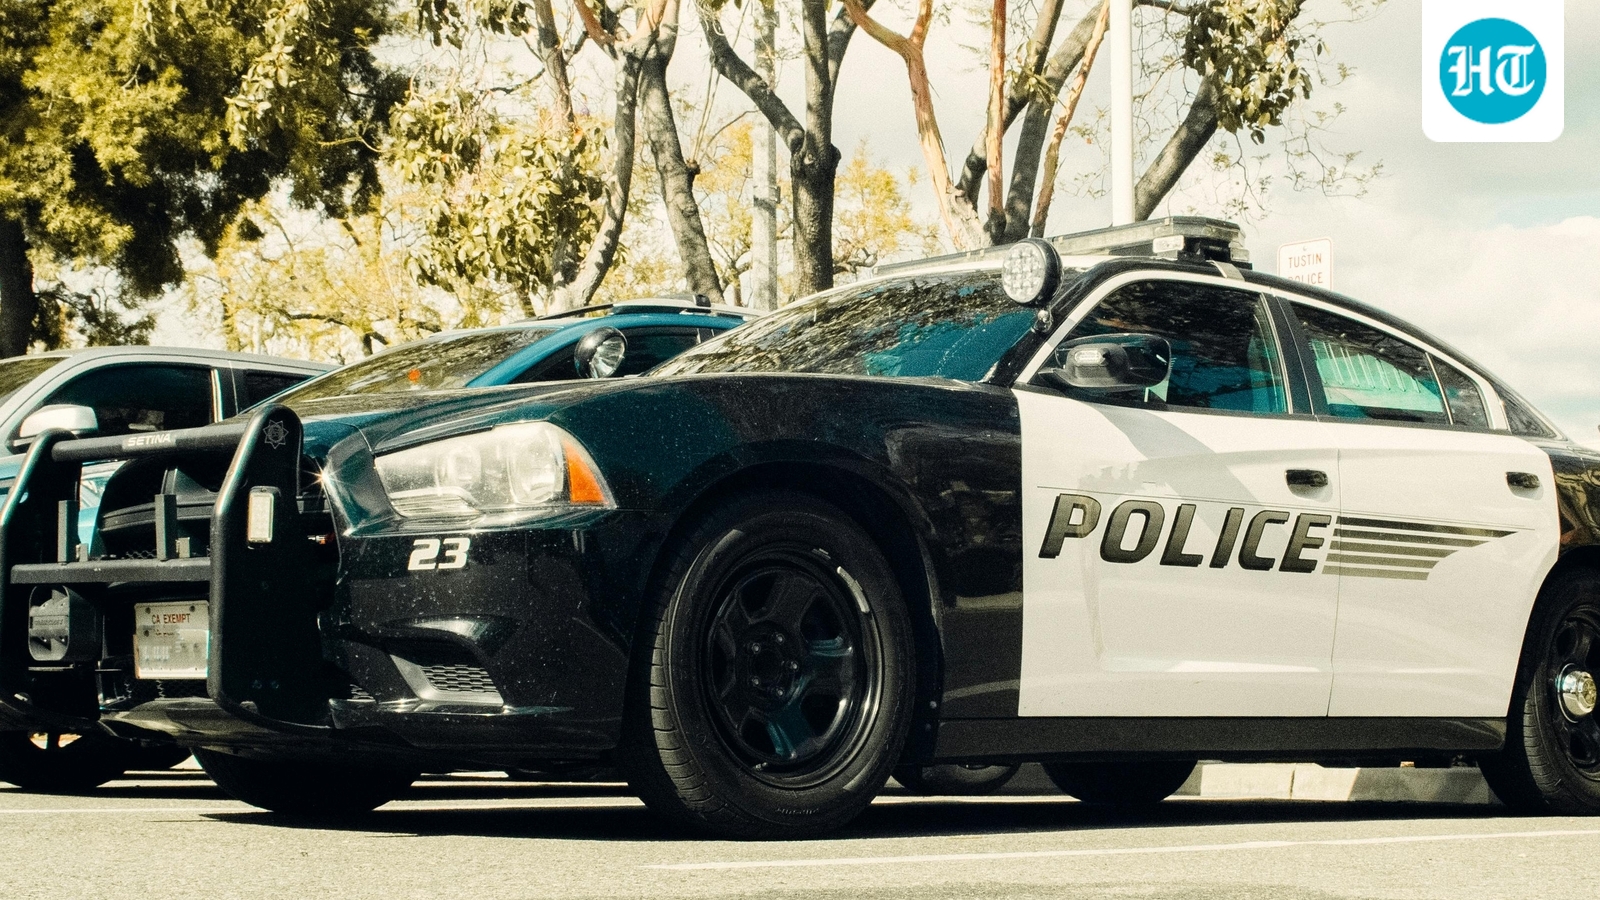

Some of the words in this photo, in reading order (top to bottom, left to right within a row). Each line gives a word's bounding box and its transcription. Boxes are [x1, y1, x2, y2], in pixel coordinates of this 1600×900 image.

[1288, 253, 1322, 268] TUSTIN
[1288, 272, 1323, 285] LICE
[127, 433, 171, 447] SETINA
[1038, 493, 1332, 574] POLICE
[408, 537, 471, 571] 23
[151, 614, 161, 625] CA
[163, 613, 191, 624] EXEMPT
